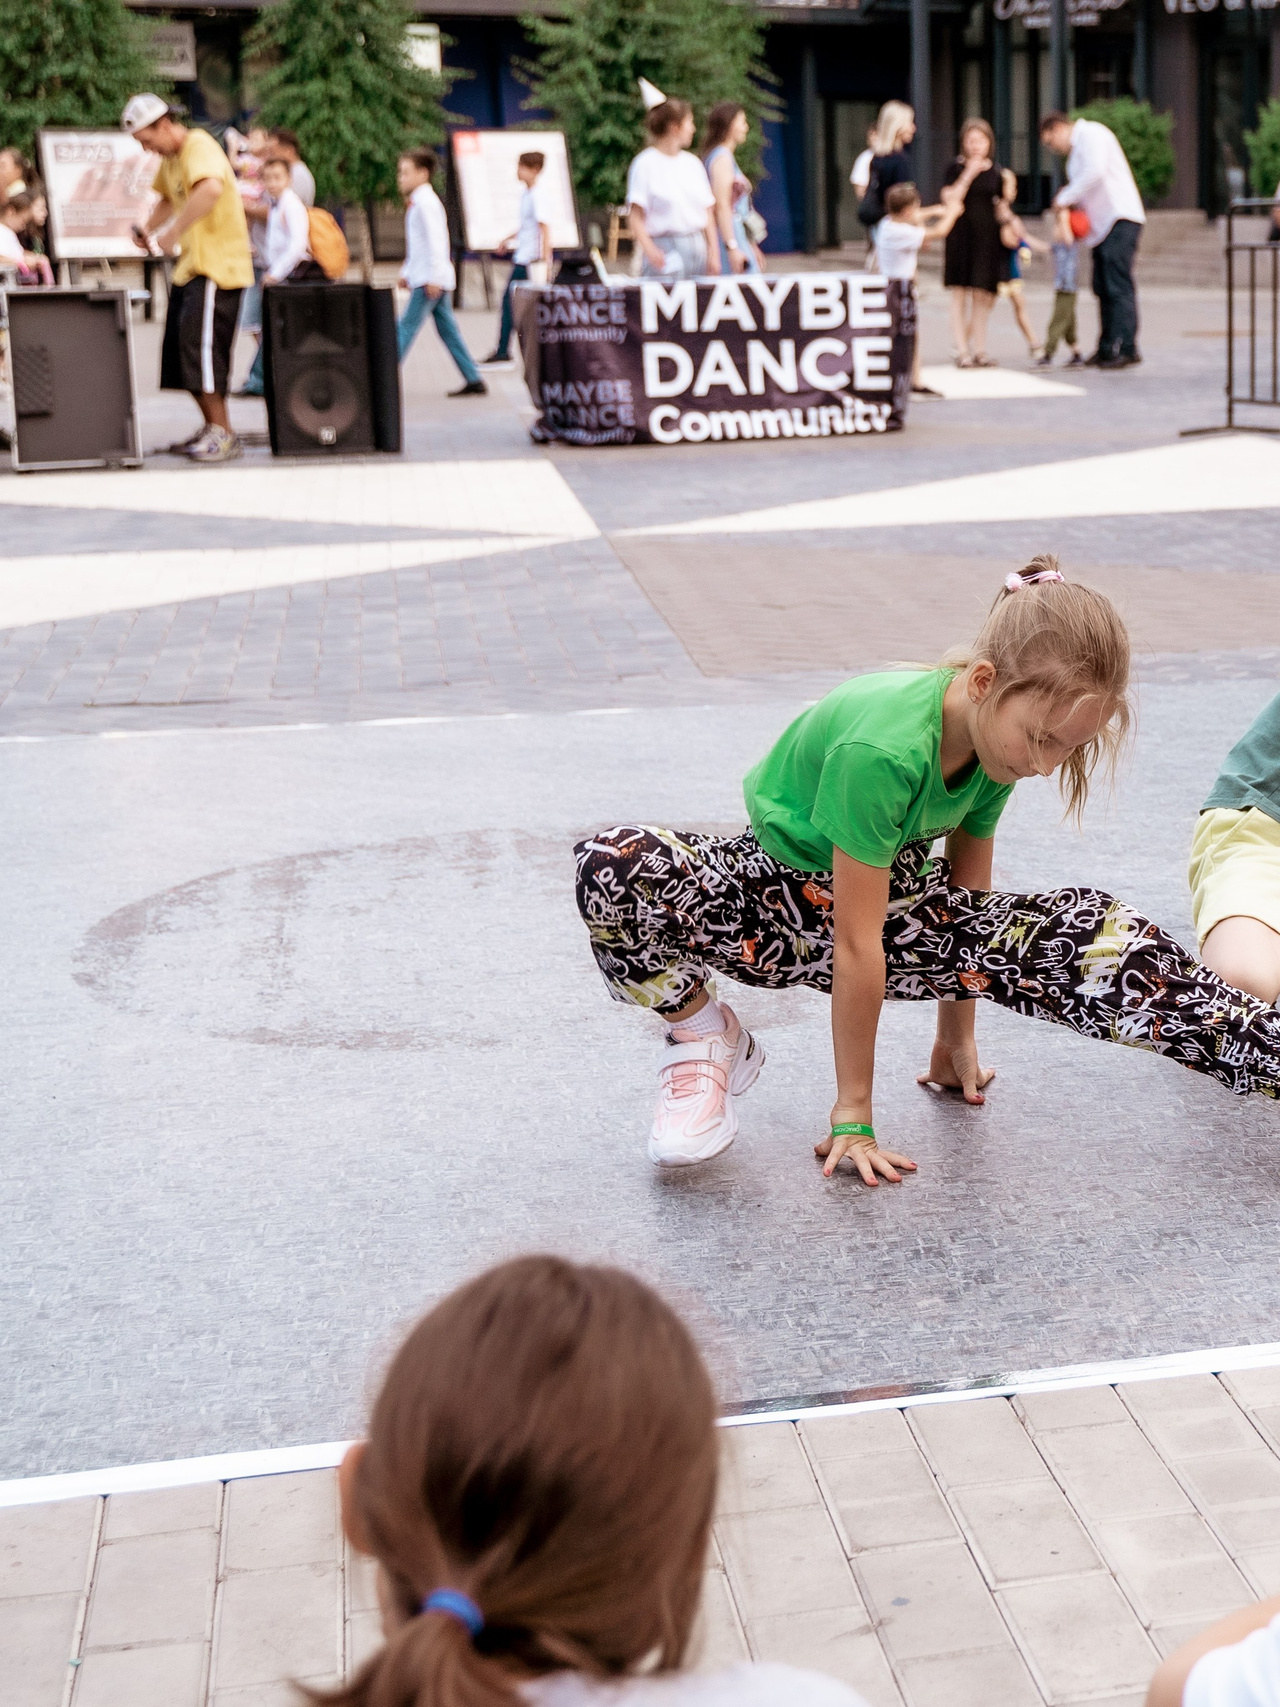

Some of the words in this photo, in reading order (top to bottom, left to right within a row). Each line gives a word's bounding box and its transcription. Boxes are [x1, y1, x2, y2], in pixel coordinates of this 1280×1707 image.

[537, 301, 627, 325] DANCE
[641, 275, 893, 333] MAYBE
[540, 325, 627, 344] Community
[642, 337, 893, 398] DANCE
[542, 379, 633, 405] MAYBE
[547, 404, 635, 428] DANCE
[648, 398, 892, 444] Community
